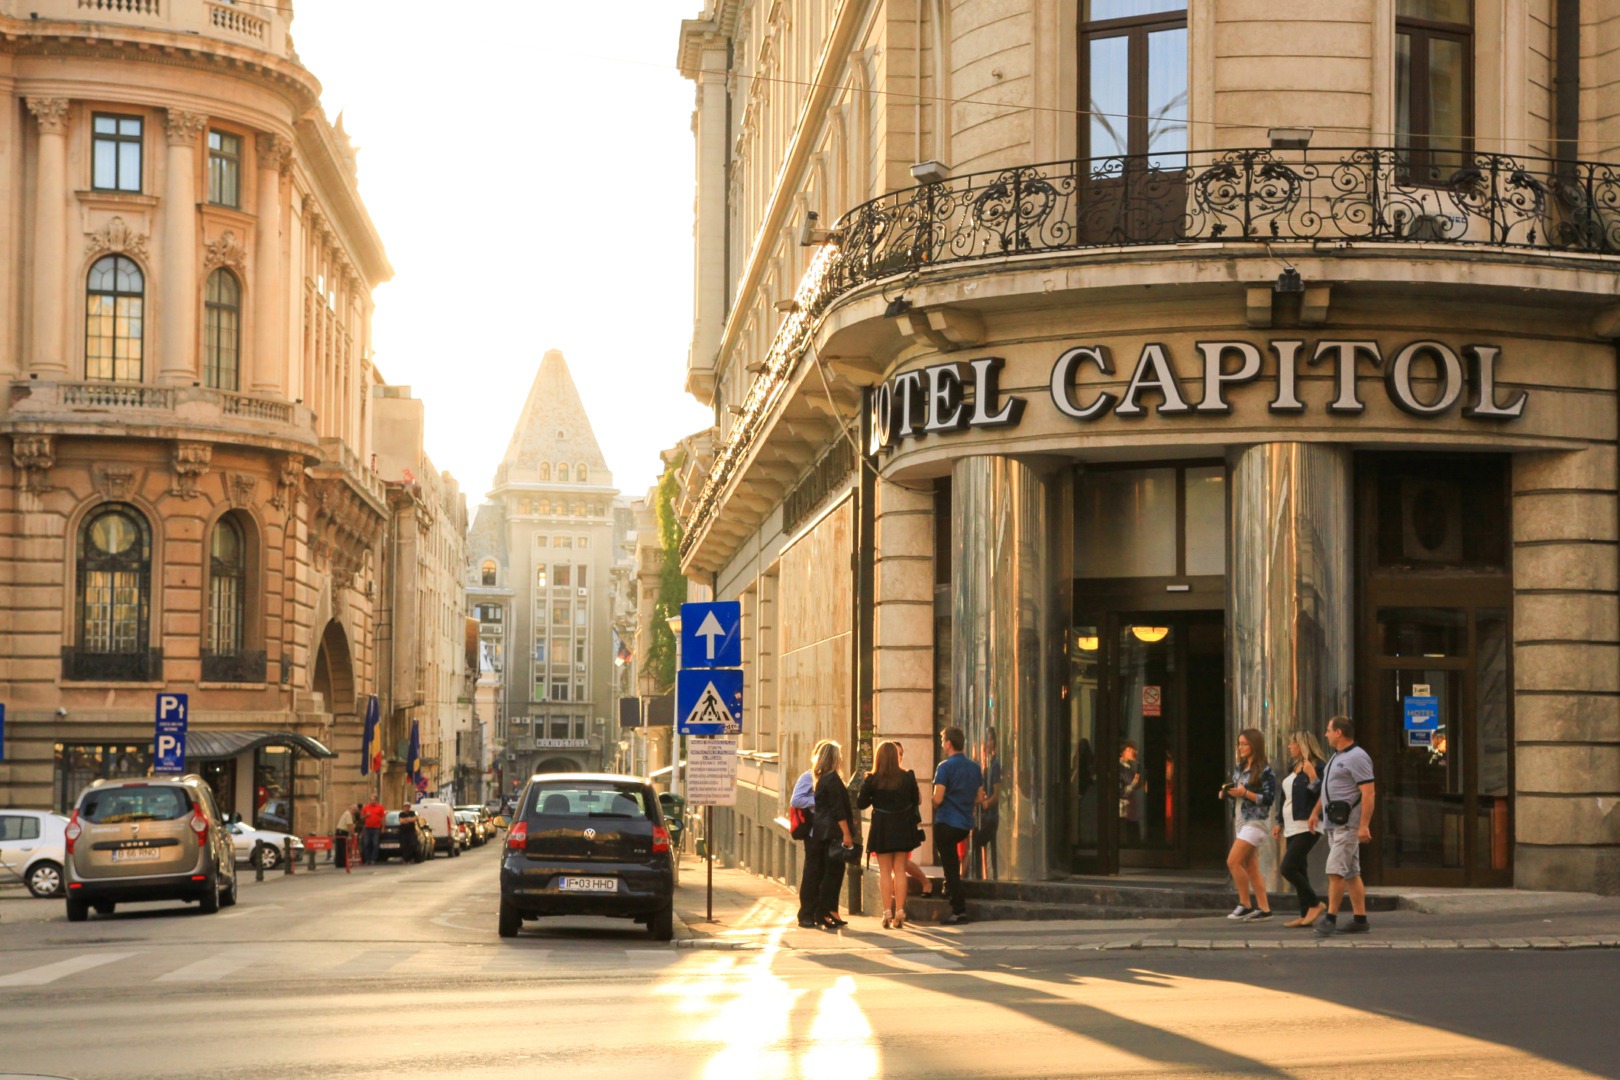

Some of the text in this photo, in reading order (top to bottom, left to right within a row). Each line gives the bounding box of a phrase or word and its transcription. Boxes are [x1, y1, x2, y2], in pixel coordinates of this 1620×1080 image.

[869, 337, 1529, 456] HOTEL CAPITOL
[160, 696, 178, 719] P
[1407, 709, 1436, 717] HOTEL
[158, 735, 176, 758] P
[566, 878, 614, 890] IF 03 HHD
